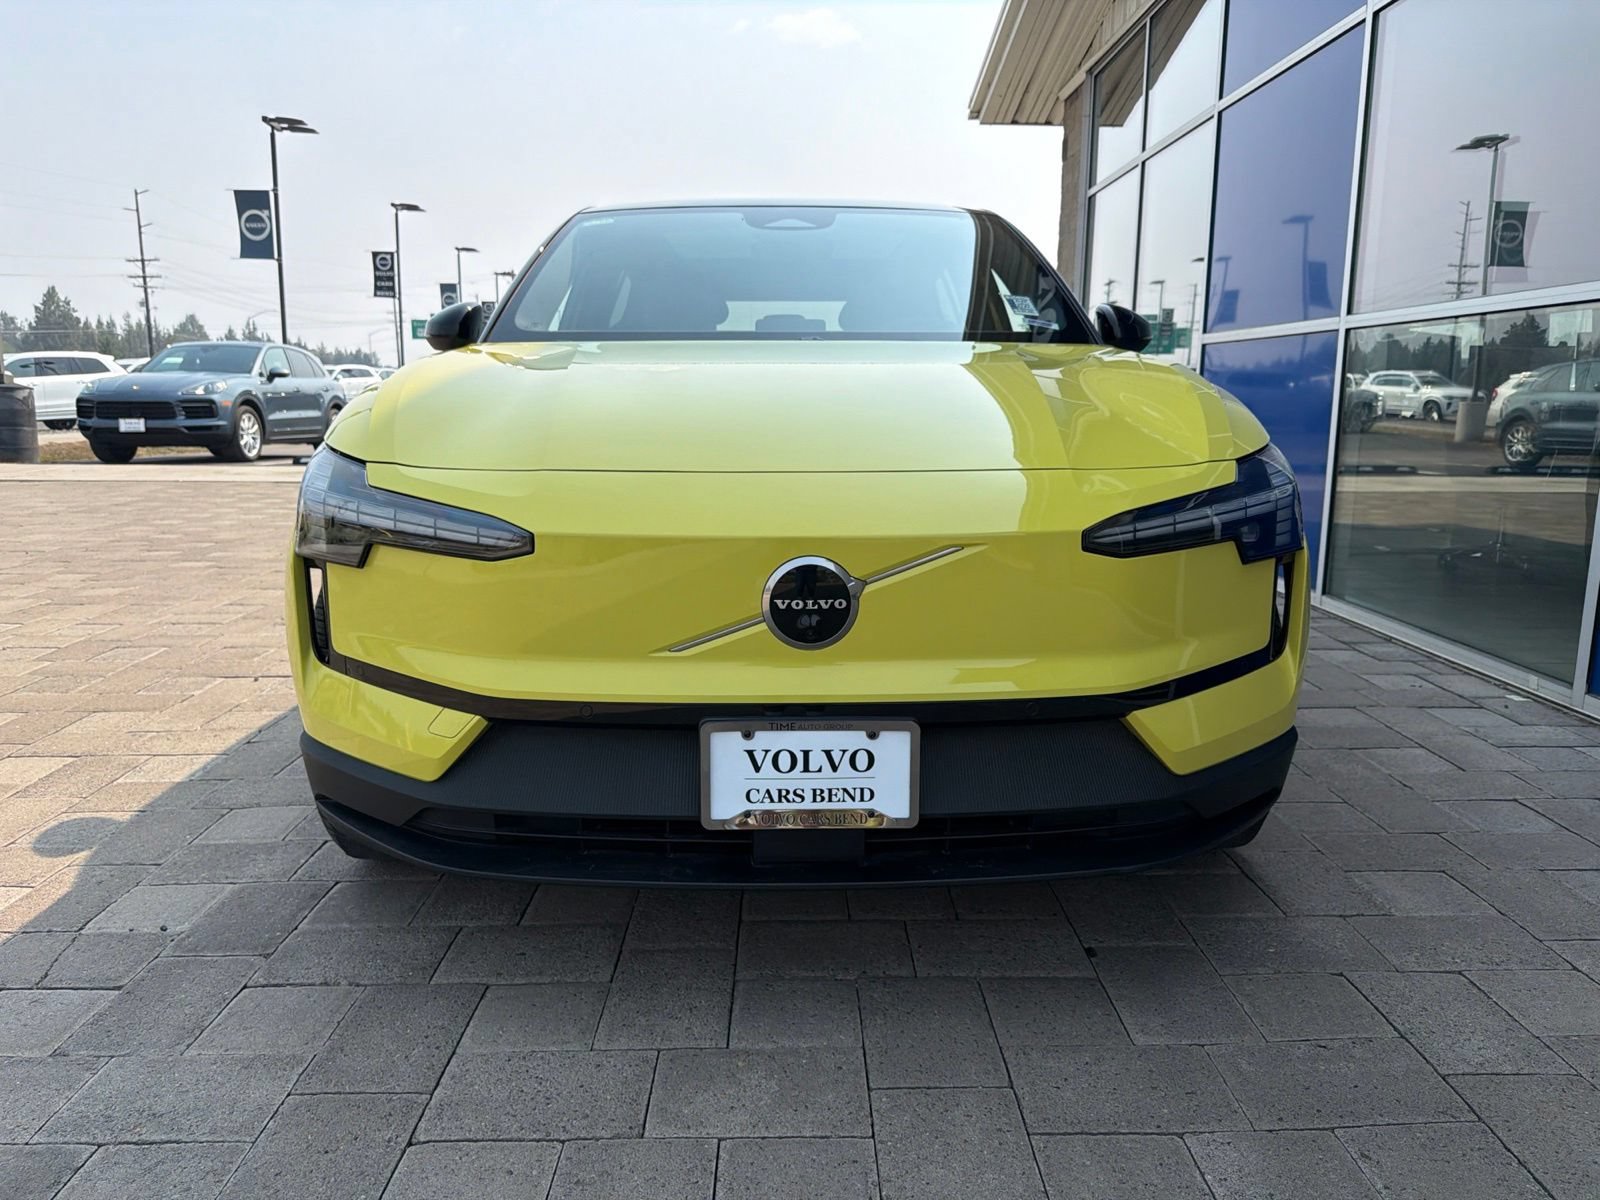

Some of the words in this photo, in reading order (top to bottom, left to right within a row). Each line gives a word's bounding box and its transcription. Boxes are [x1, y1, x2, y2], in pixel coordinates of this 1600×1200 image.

[773, 598, 847, 610] VOLVO
[768, 722, 797, 731] TIME
[798, 723, 821, 731] AUTO
[743, 748, 876, 774] VOLVO
[745, 788, 805, 804] CARS
[810, 787, 875, 803] BEND
[753, 813, 796, 826] VOLVO
[798, 813, 831, 826] CARS
[835, 812, 868, 825] BEND
